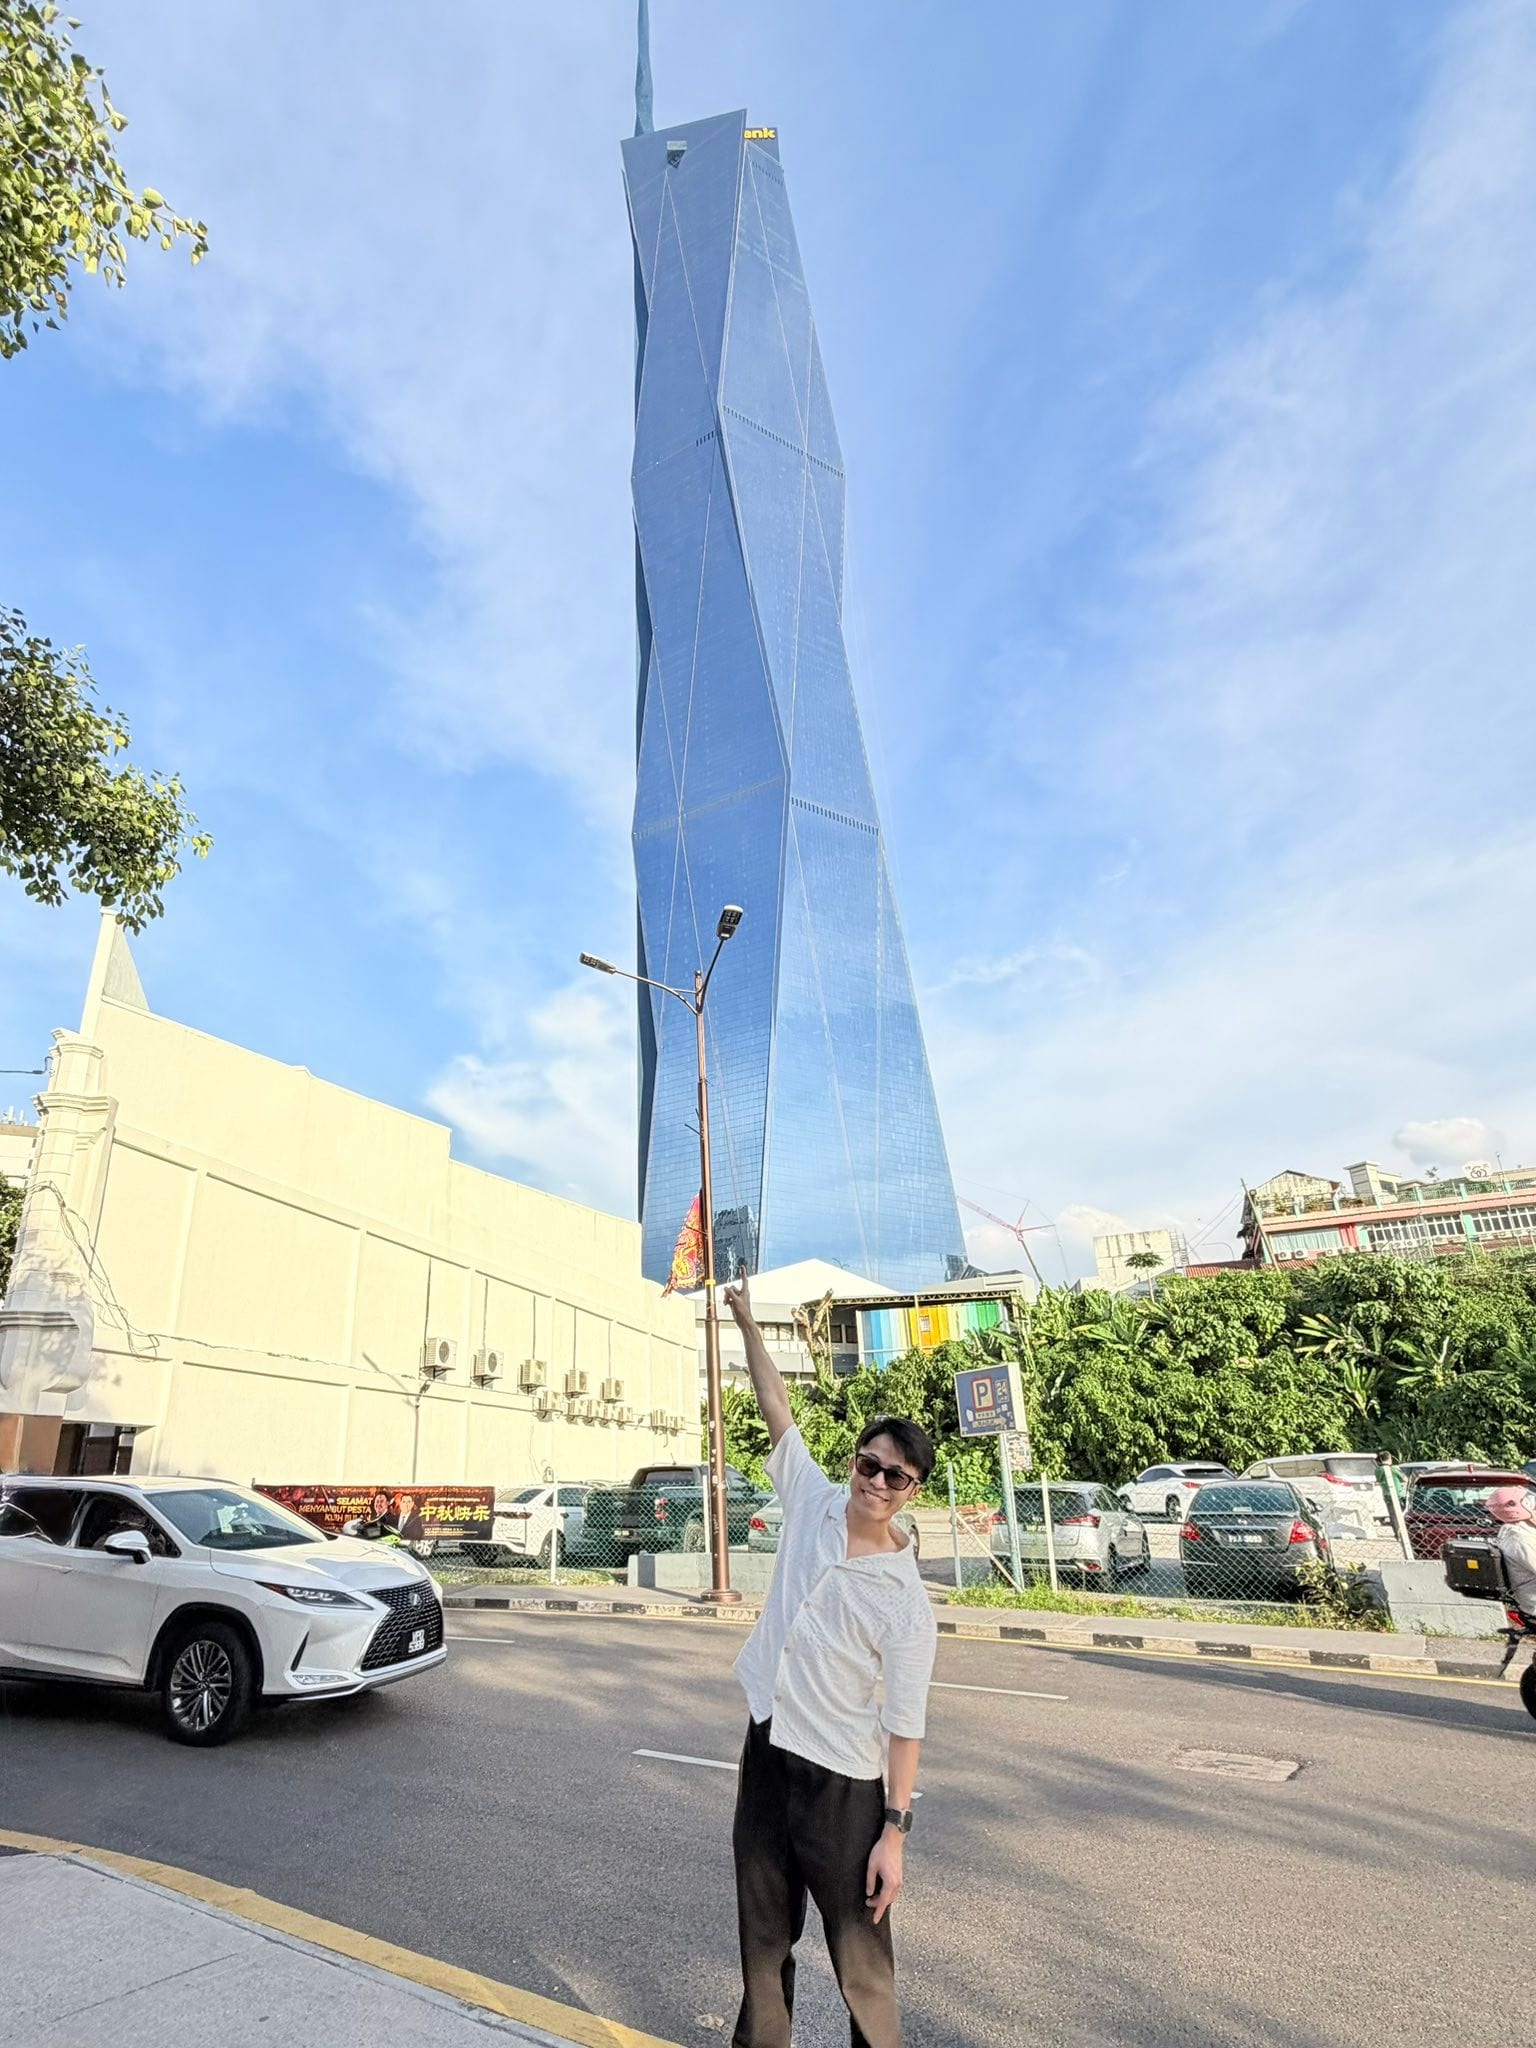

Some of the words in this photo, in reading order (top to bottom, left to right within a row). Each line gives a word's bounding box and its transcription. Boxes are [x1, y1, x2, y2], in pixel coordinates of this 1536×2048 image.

[975, 1382, 988, 1406] P
[336, 1497, 373, 1505] SELAMAT
[347, 1505, 372, 1514] PESTA
[418, 1504, 490, 1521] 中秋快乐
